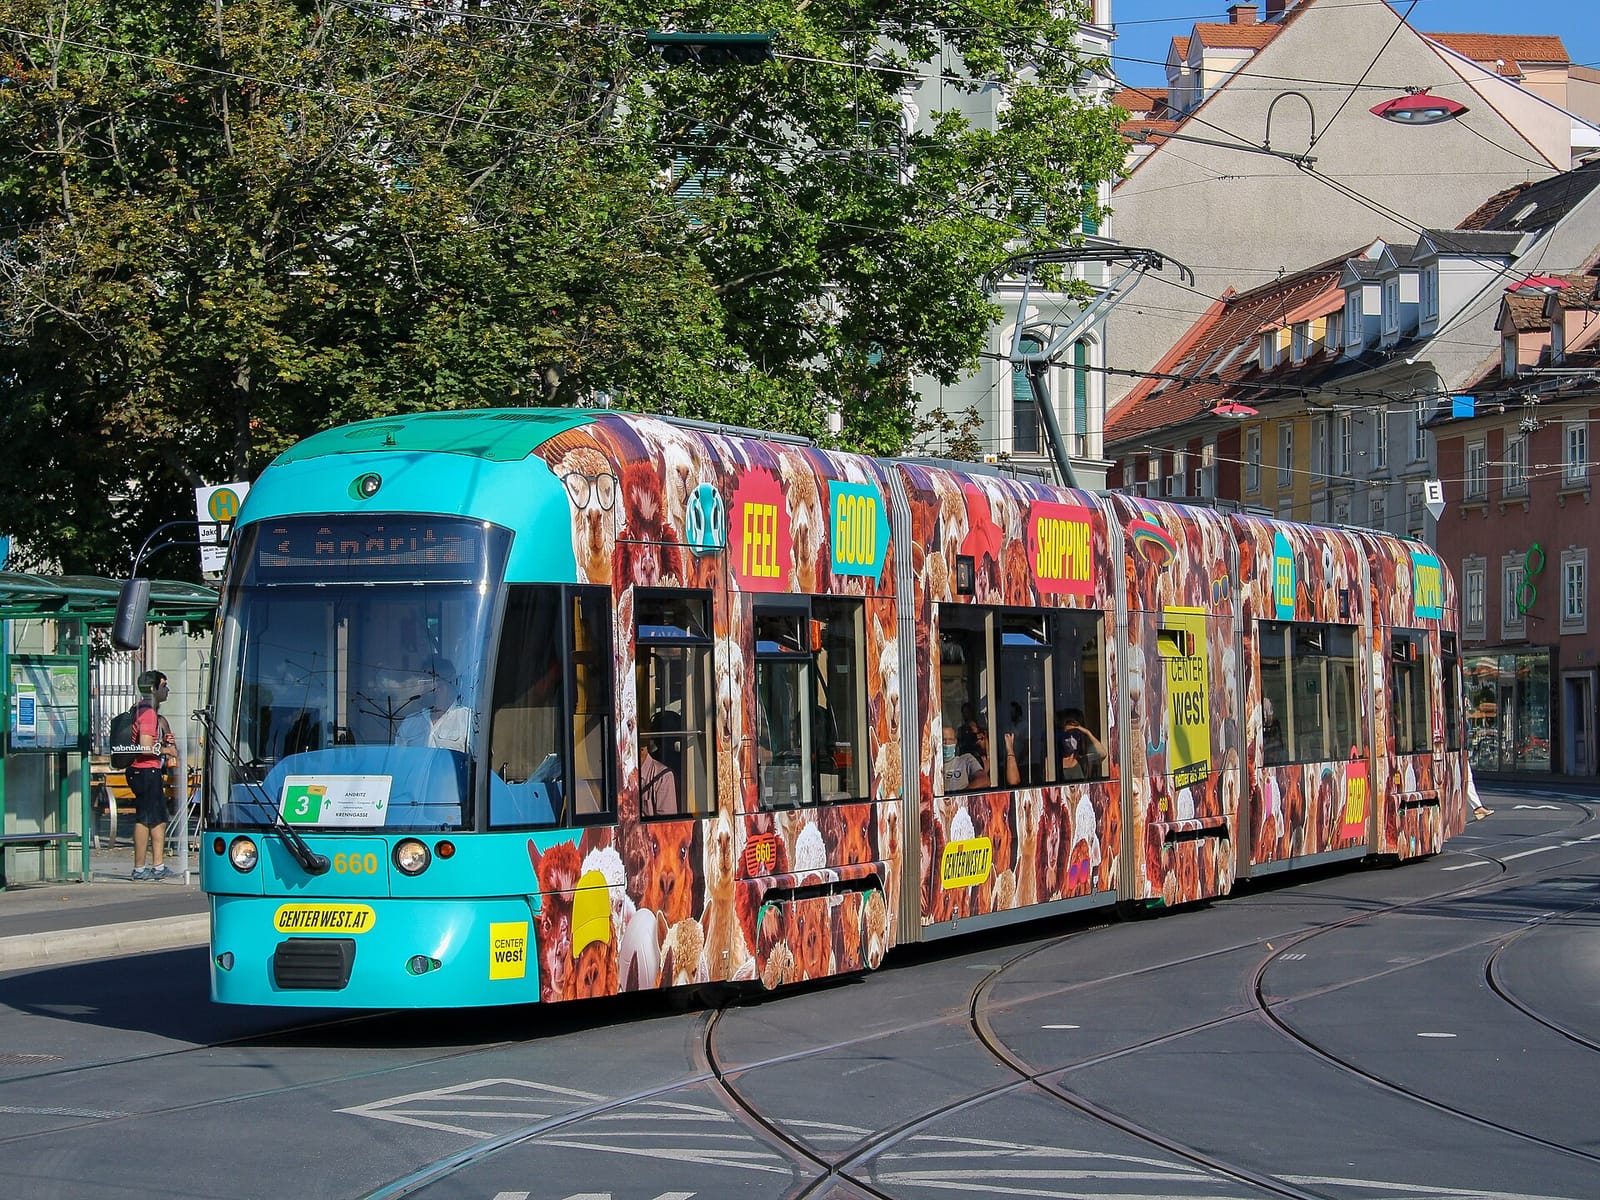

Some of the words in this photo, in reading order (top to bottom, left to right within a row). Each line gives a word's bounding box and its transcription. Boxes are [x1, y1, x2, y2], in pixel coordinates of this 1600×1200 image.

[1429, 486, 1439, 499] E
[216, 495, 232, 516] H
[742, 502, 780, 578] FEEL
[836, 493, 876, 565] GOOD
[1037, 517, 1090, 581] SHOPPING
[1276, 556, 1293, 607] FEEL
[1171, 656, 1204, 682] CENTER
[1173, 683, 1205, 725] west
[295, 796, 309, 815] 3
[1345, 777, 1365, 825] GOOD
[333, 852, 378, 875] 660
[756, 842, 770, 862] 660
[495, 938, 523, 948] CENTER
[495, 947, 523, 962] west
